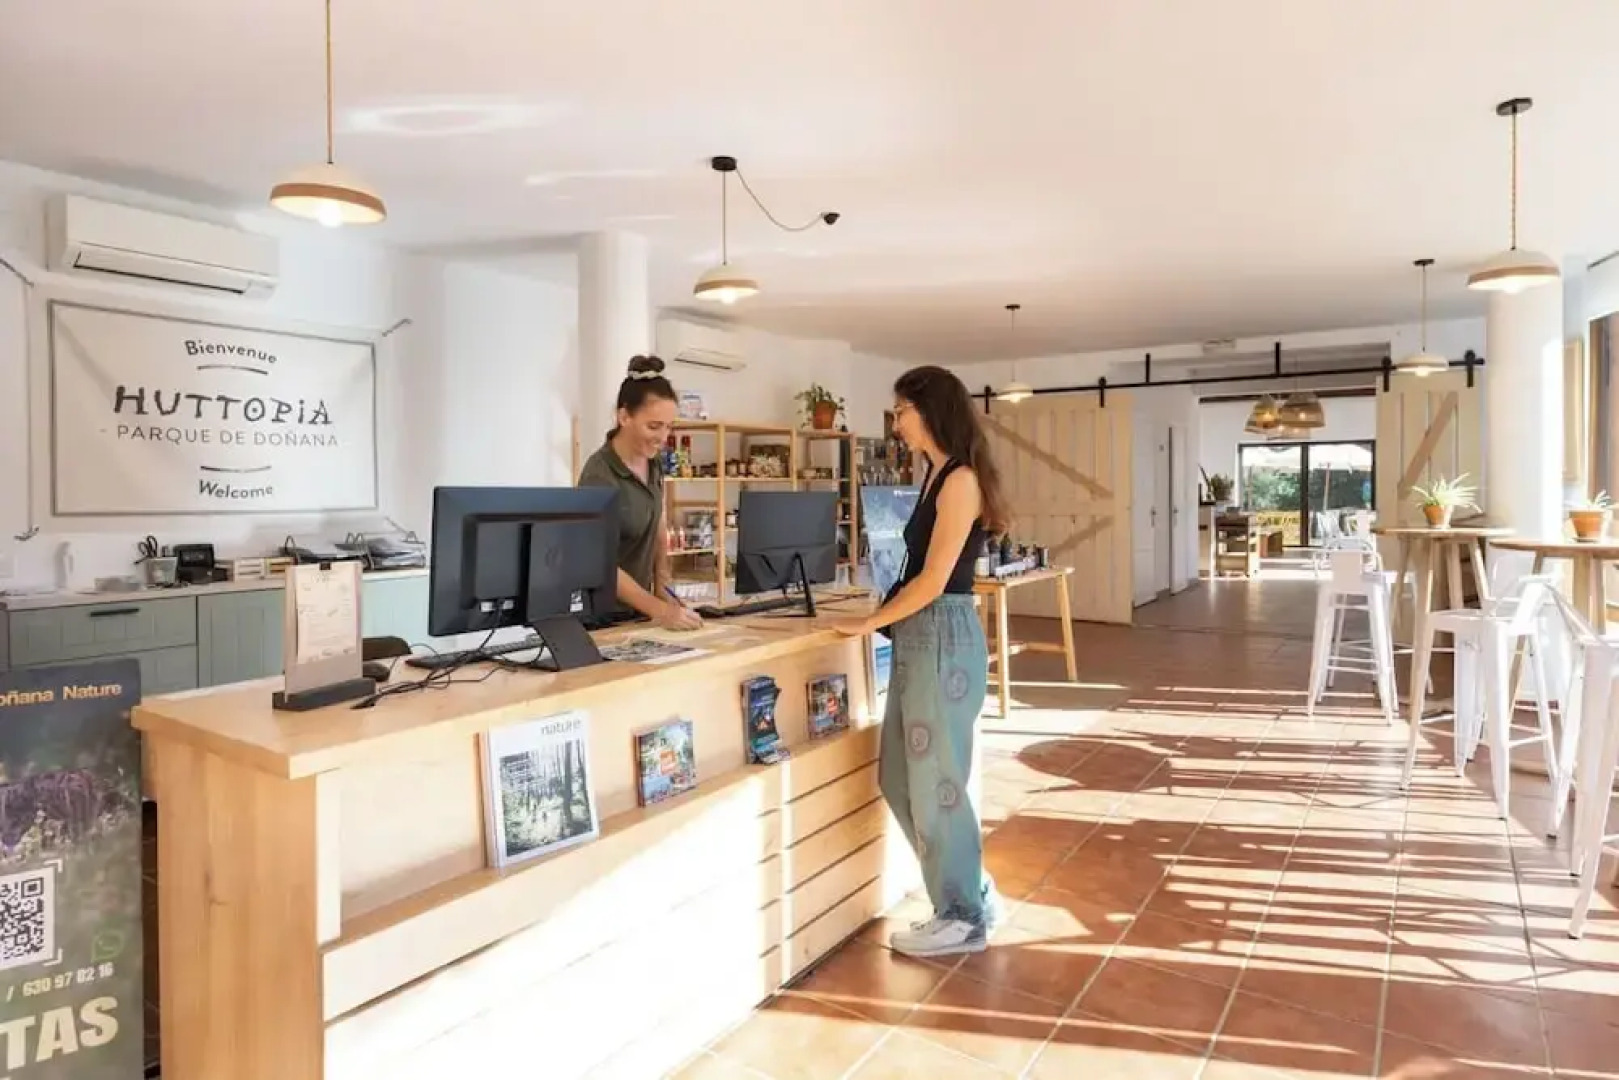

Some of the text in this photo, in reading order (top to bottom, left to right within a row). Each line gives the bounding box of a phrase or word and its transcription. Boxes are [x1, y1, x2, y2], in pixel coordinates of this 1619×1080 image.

[185, 340, 277, 363] Bienvenue
[117, 425, 339, 447] PARQUE DE DOÑANA
[199, 479, 273, 499] Welcome
[62, 684, 122, 700] Nature
[542, 719, 581, 735] nature
[23, 978, 51, 996] 630
[54, 971, 73, 988] 97
[0, 996, 119, 1070] TAS
